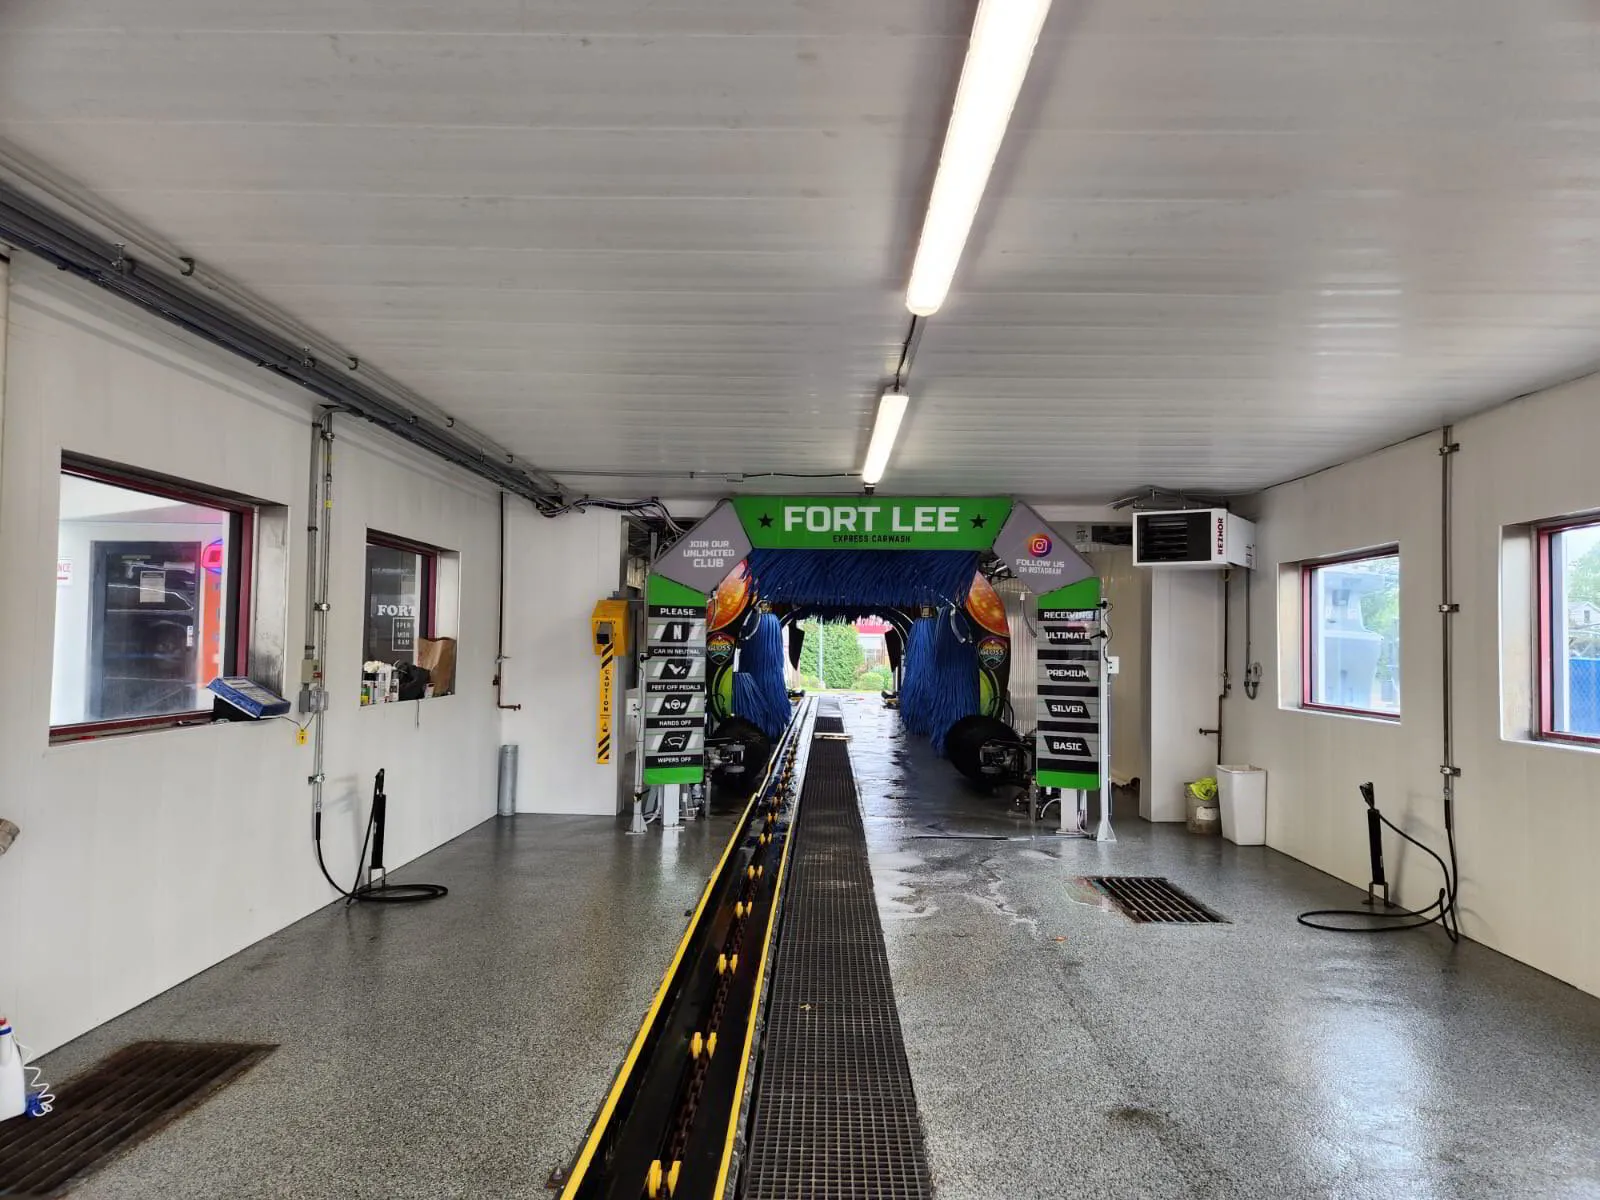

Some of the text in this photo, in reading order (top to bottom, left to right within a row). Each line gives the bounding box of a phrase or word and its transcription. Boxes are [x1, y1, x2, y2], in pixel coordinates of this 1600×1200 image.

[784, 506, 960, 532] FORT LEE
[832, 535, 911, 543] EXPRESS CARWASH
[683, 549, 735, 557] UNLIMITED
[693, 558, 724, 568] CLUB
[1016, 559, 1050, 567] FOLLOW
[1052, 705, 1084, 713] SILVER
[1053, 742, 1082, 751] BASIC
